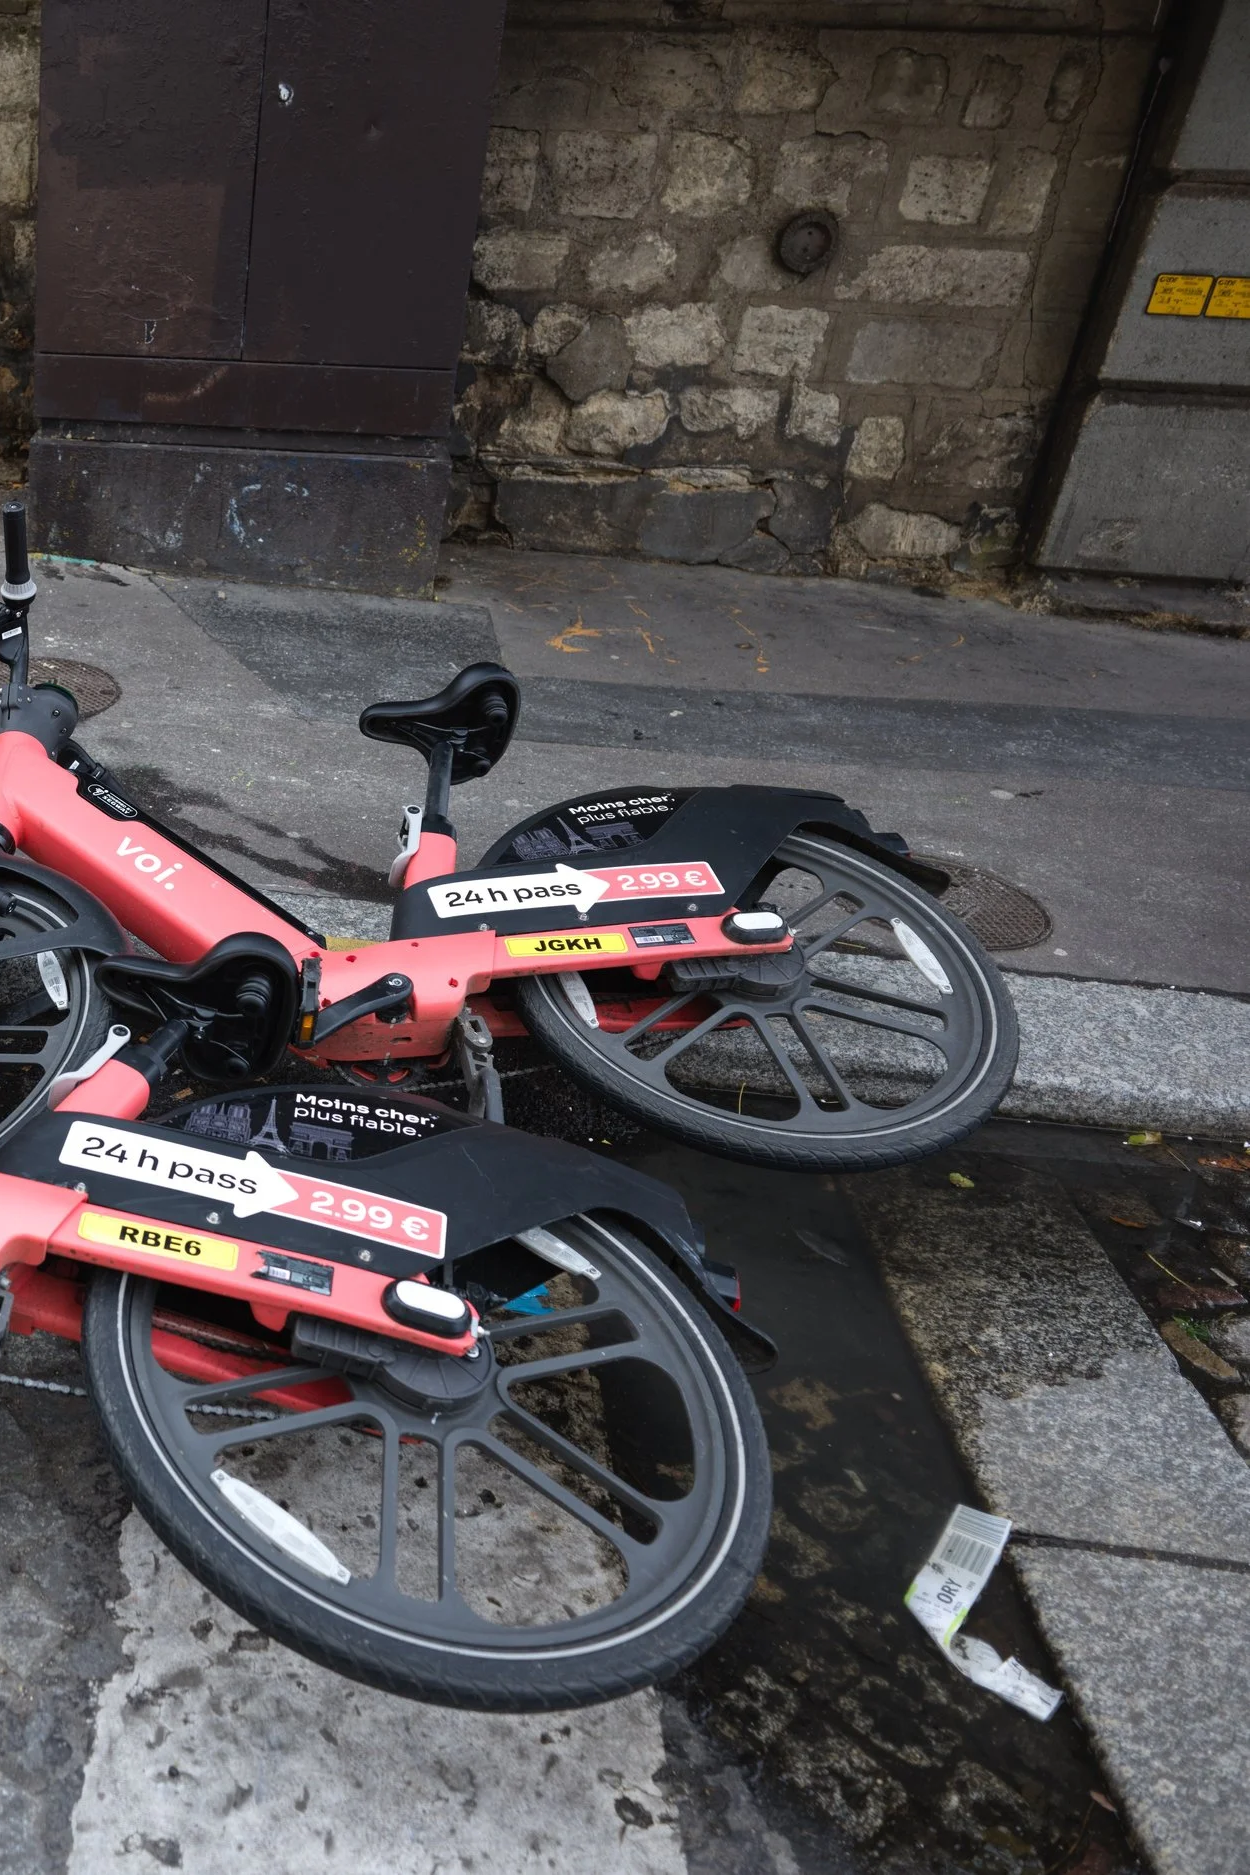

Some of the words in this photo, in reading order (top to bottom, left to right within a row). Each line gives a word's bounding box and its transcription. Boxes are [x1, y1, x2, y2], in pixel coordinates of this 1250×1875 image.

[102, 795, 130, 815] SEGWAY
[568, 801, 627, 815] Moins
[629, 795, 675, 806] cher,
[577, 809, 616, 824] plus
[618, 803, 674, 818] fiable.
[116, 836, 183, 890] voi.
[445, 889, 483, 908] 24
[490, 886, 508, 902] h
[516, 883, 583, 903] pass
[617, 871, 680, 890] 2.99
[684, 870, 707, 887] €
[534, 937, 603, 952] JGKH
[294, 1107, 343, 1124] plus
[350, 1114, 422, 1138] fiable.
[296, 1093, 370, 1114] Moins
[375, 1108, 435, 1128] cher,
[81, 1136, 128, 1164] 24
[137, 1150, 159, 1171] h
[168, 1160, 259, 1195] pass
[309, 1190, 393, 1230] 2.99
[401, 1216, 430, 1242] €
[118, 1225, 202, 1257] RBE6
[937, 1578, 963, 1605] ORY
